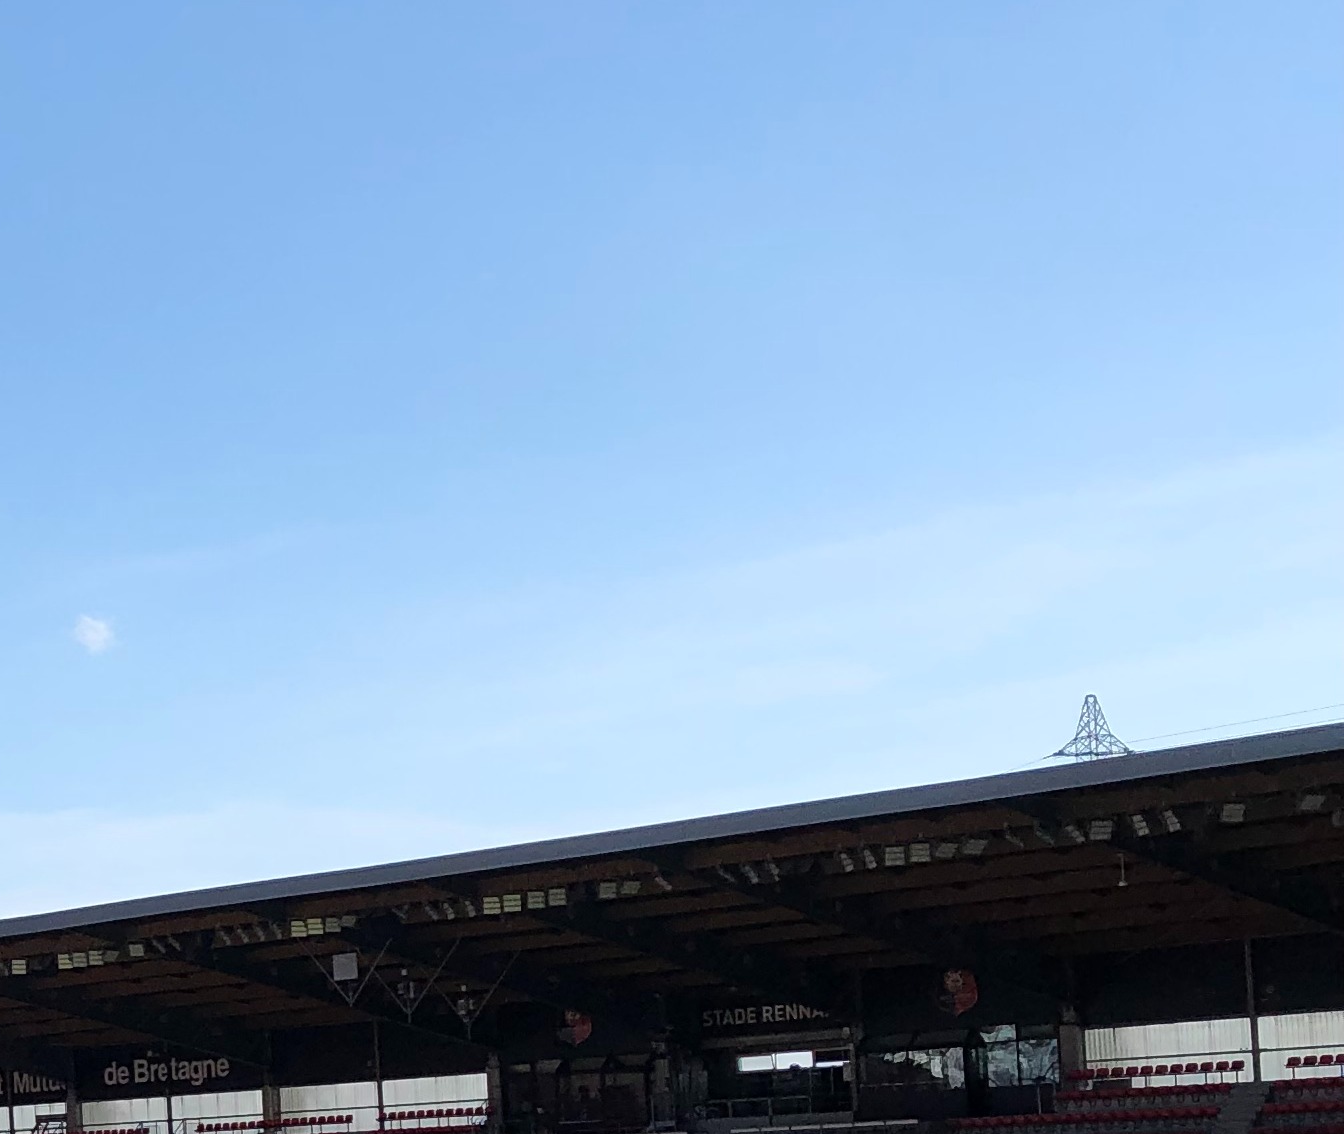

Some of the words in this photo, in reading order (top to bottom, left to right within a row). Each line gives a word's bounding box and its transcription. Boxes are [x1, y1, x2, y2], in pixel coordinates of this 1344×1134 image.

[702, 1007, 757, 1027] STADE
[761, 1003, 830, 1022] RENNA
[13, 1070, 67, 1095] Mutu
[104, 1061, 130, 1085] de
[133, 1058, 230, 1087] Bretagne
